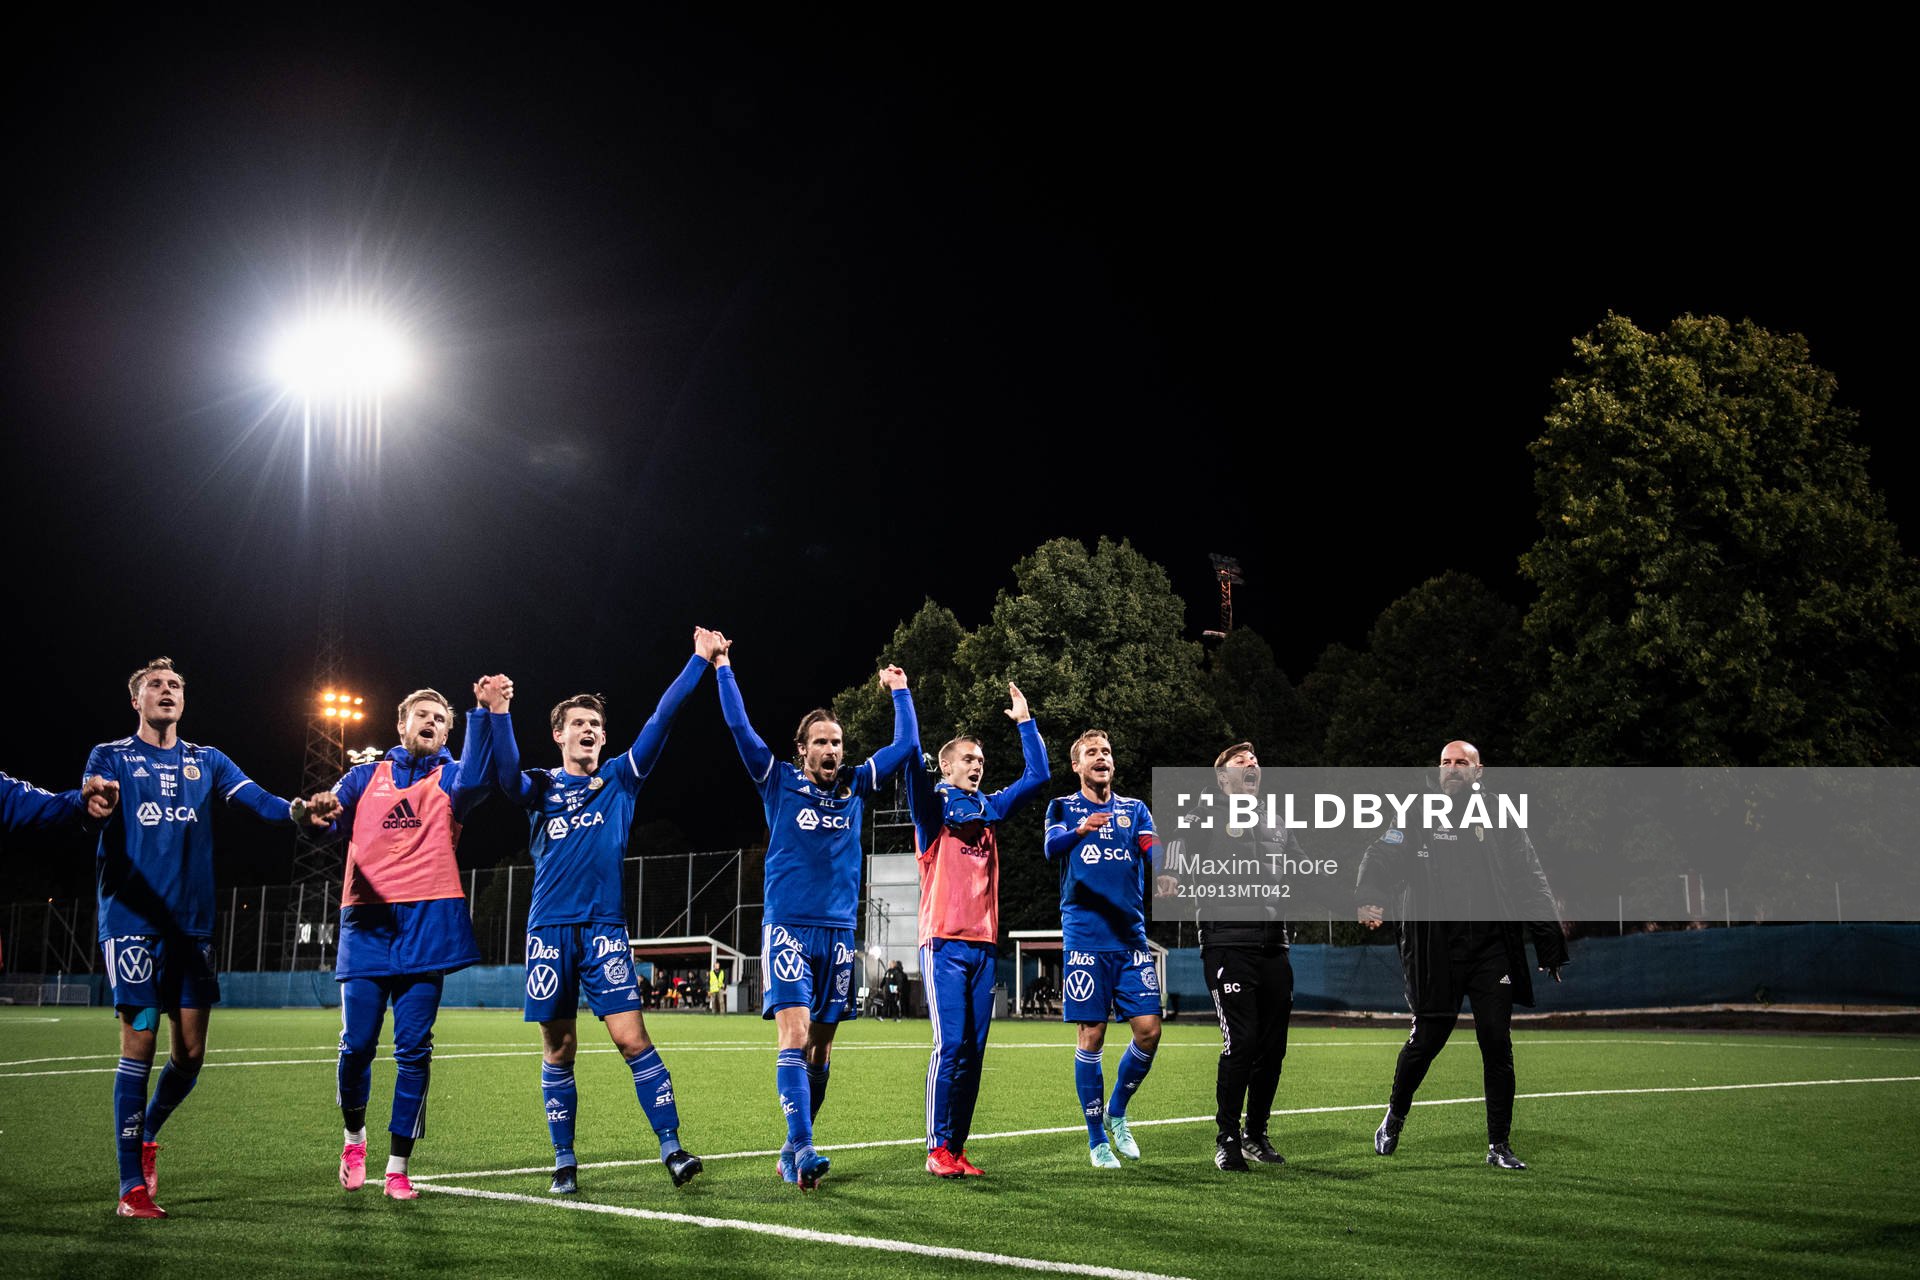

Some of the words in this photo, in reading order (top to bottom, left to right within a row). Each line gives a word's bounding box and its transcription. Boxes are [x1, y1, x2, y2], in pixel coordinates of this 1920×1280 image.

[165, 806, 198, 822] SCA
[570, 811, 604, 830] SCA
[822, 816, 850, 830] SCA
[1104, 848, 1132, 862] SCA
[528, 936, 560, 960] Diös
[592, 936, 627, 958] Diös
[1223, 982, 1241, 994] BC
